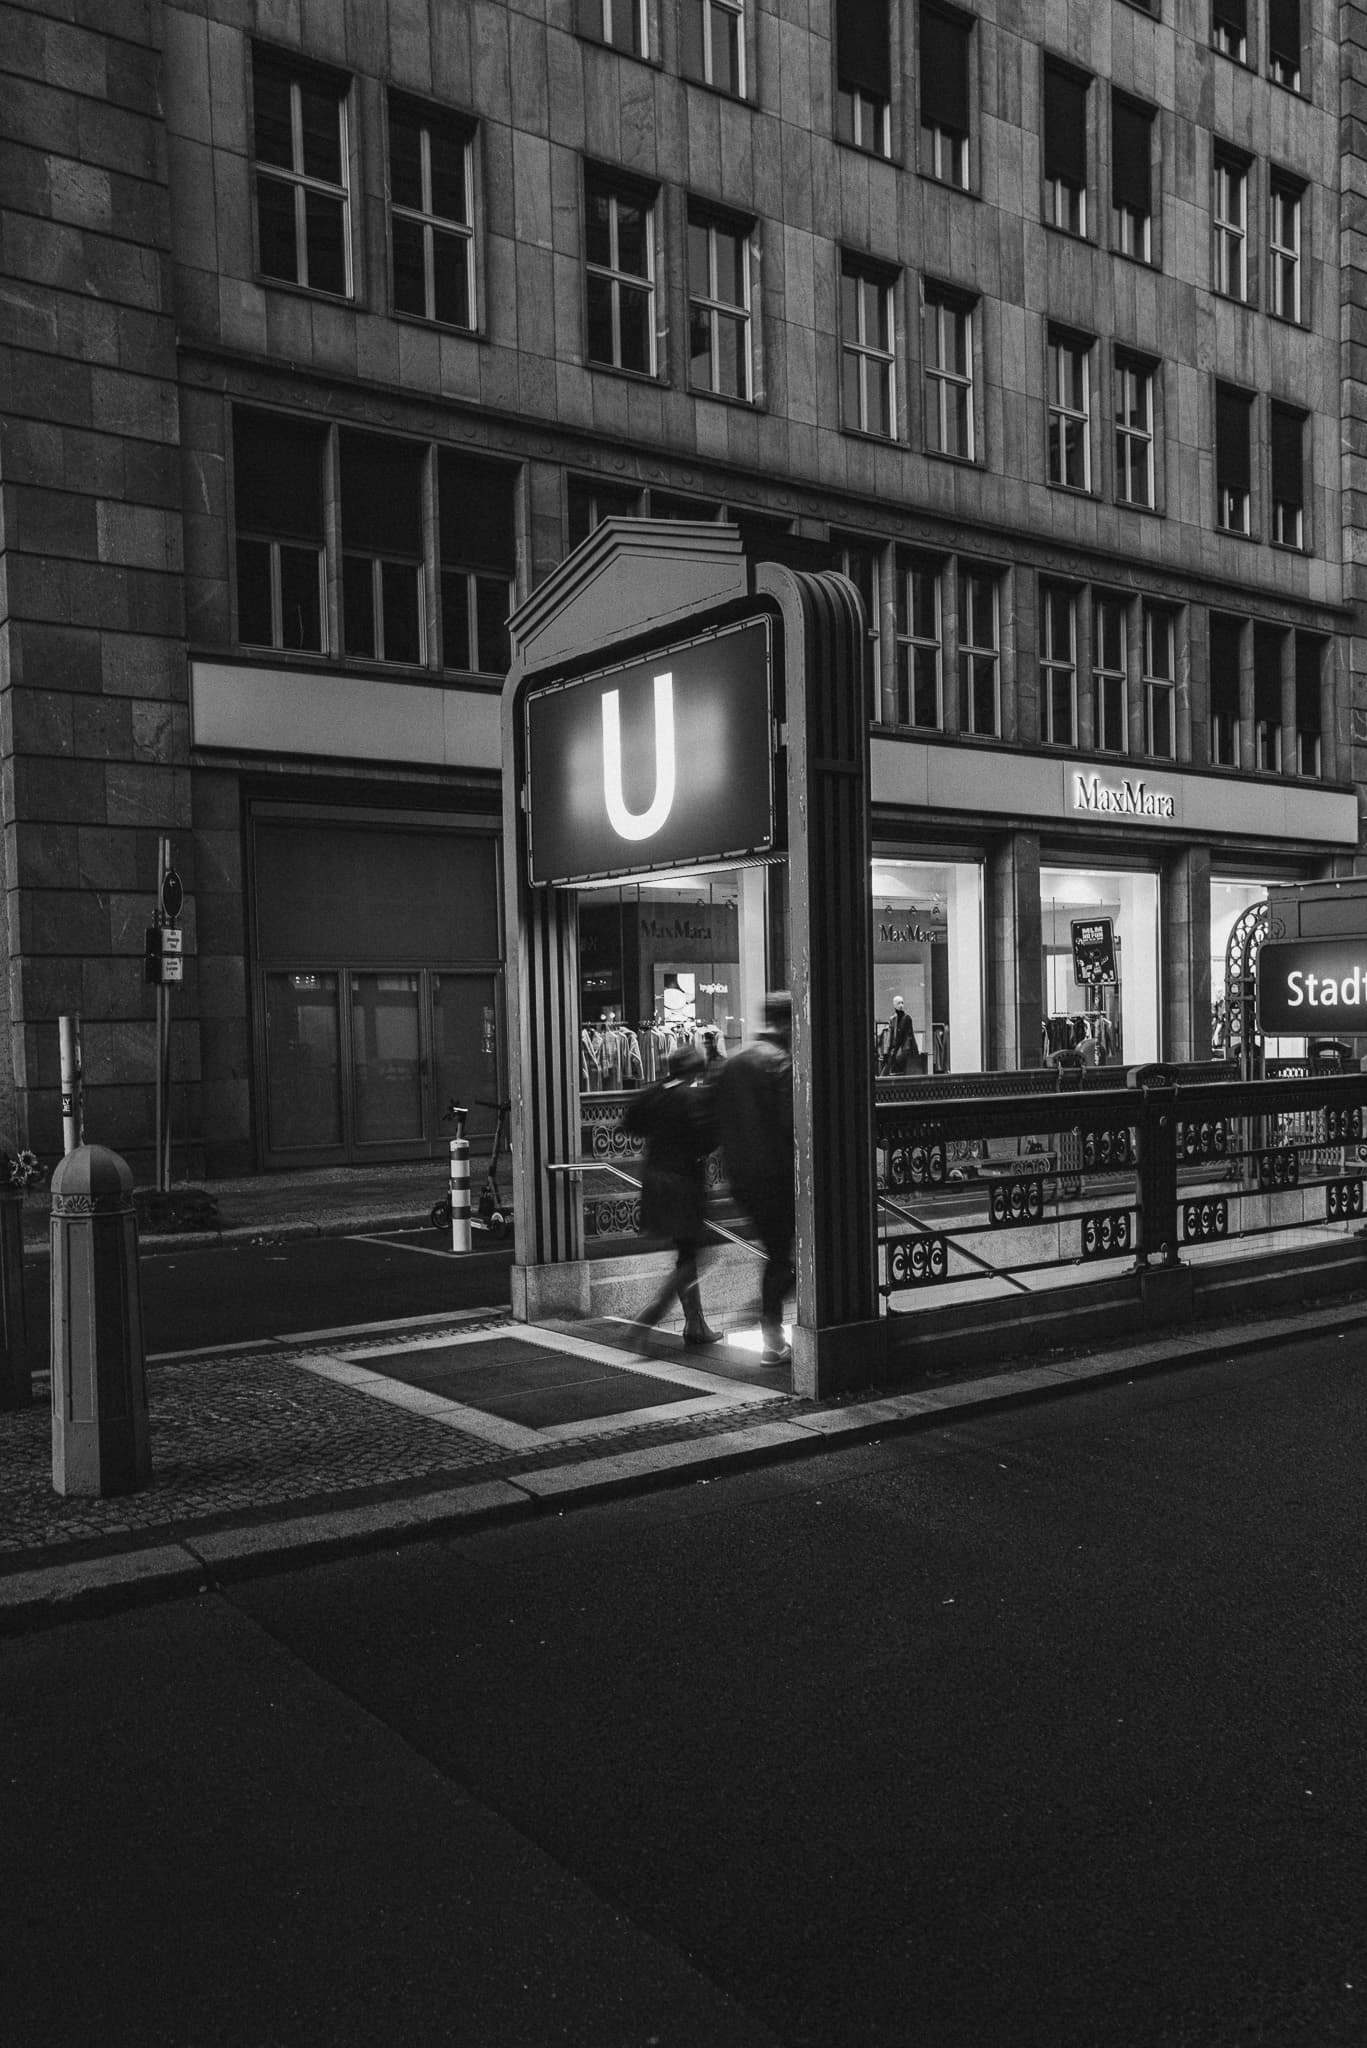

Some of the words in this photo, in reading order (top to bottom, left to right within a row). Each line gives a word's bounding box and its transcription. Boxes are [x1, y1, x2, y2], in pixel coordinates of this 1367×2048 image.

[601, 671, 676, 841] U
[1074, 774, 1176, 817] MaxMara
[641, 919, 712, 939] MaxMara
[878, 923, 938, 943] MaxMara
